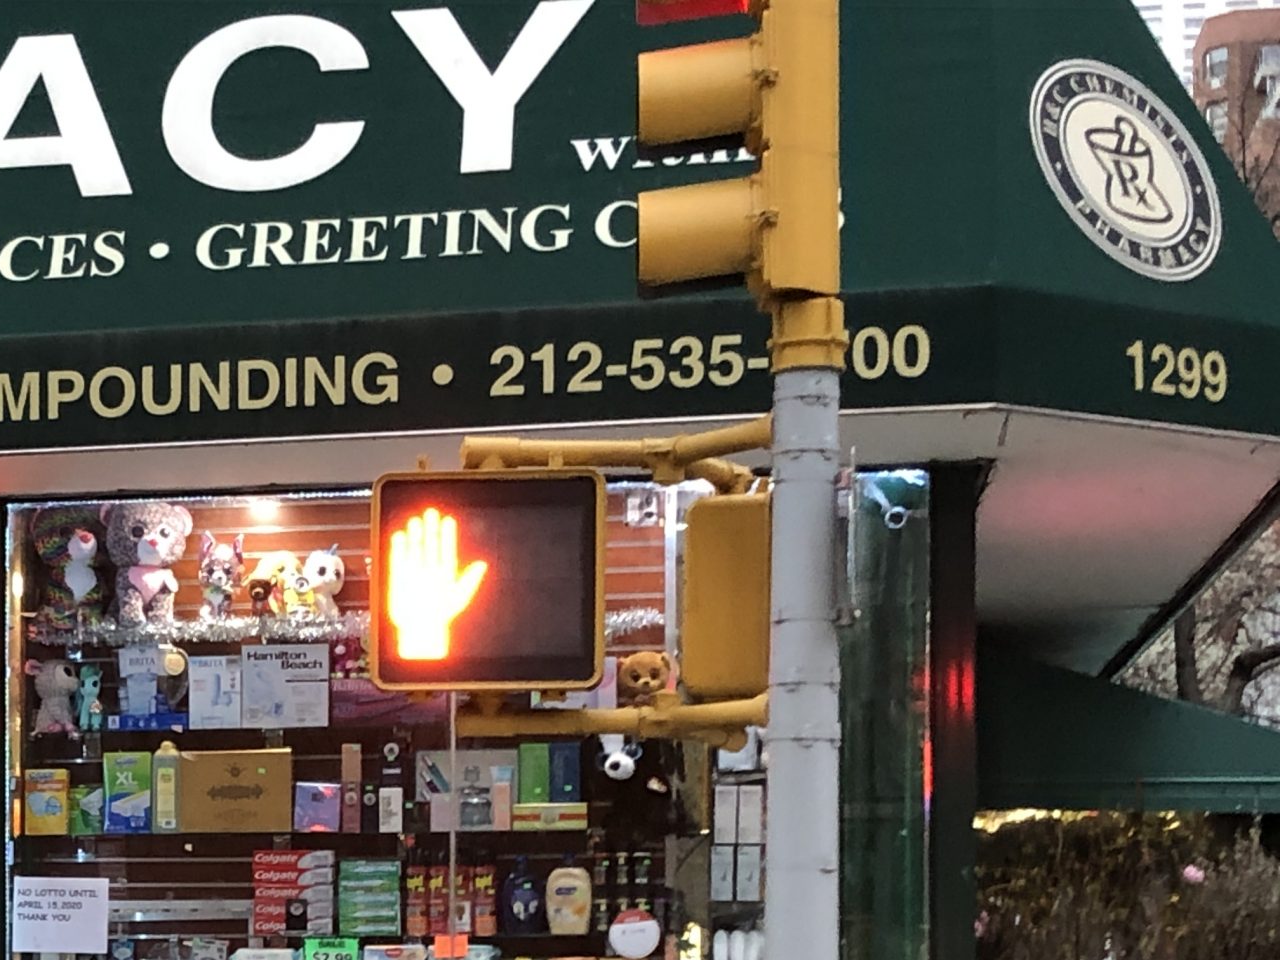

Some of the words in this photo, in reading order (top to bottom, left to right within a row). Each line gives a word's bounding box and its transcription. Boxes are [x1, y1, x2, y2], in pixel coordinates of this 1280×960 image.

[195, 202, 574, 272] GREETING
[489, 323, 931, 398] 212-535-00
[1125, 340, 1228, 403] 1299
[247, 651, 308, 661] Hamilton
[128, 657, 156, 667] BRITA
[199, 660, 223, 668] BRITA
[281, 659, 323, 670] Beach
[115, 771, 139, 786] XL
[254, 853, 299, 864] Colgate
[254, 870, 299, 881] Colgate
[17, 888, 32, 897] NO
[35, 889, 66, 898] LOTTO
[68, 889, 99, 898] UNTIL
[254, 887, 299, 898] Colgate
[17, 901, 44, 909] APRIL
[17, 913, 48, 921] THANK
[51, 913, 71, 922] YOU
